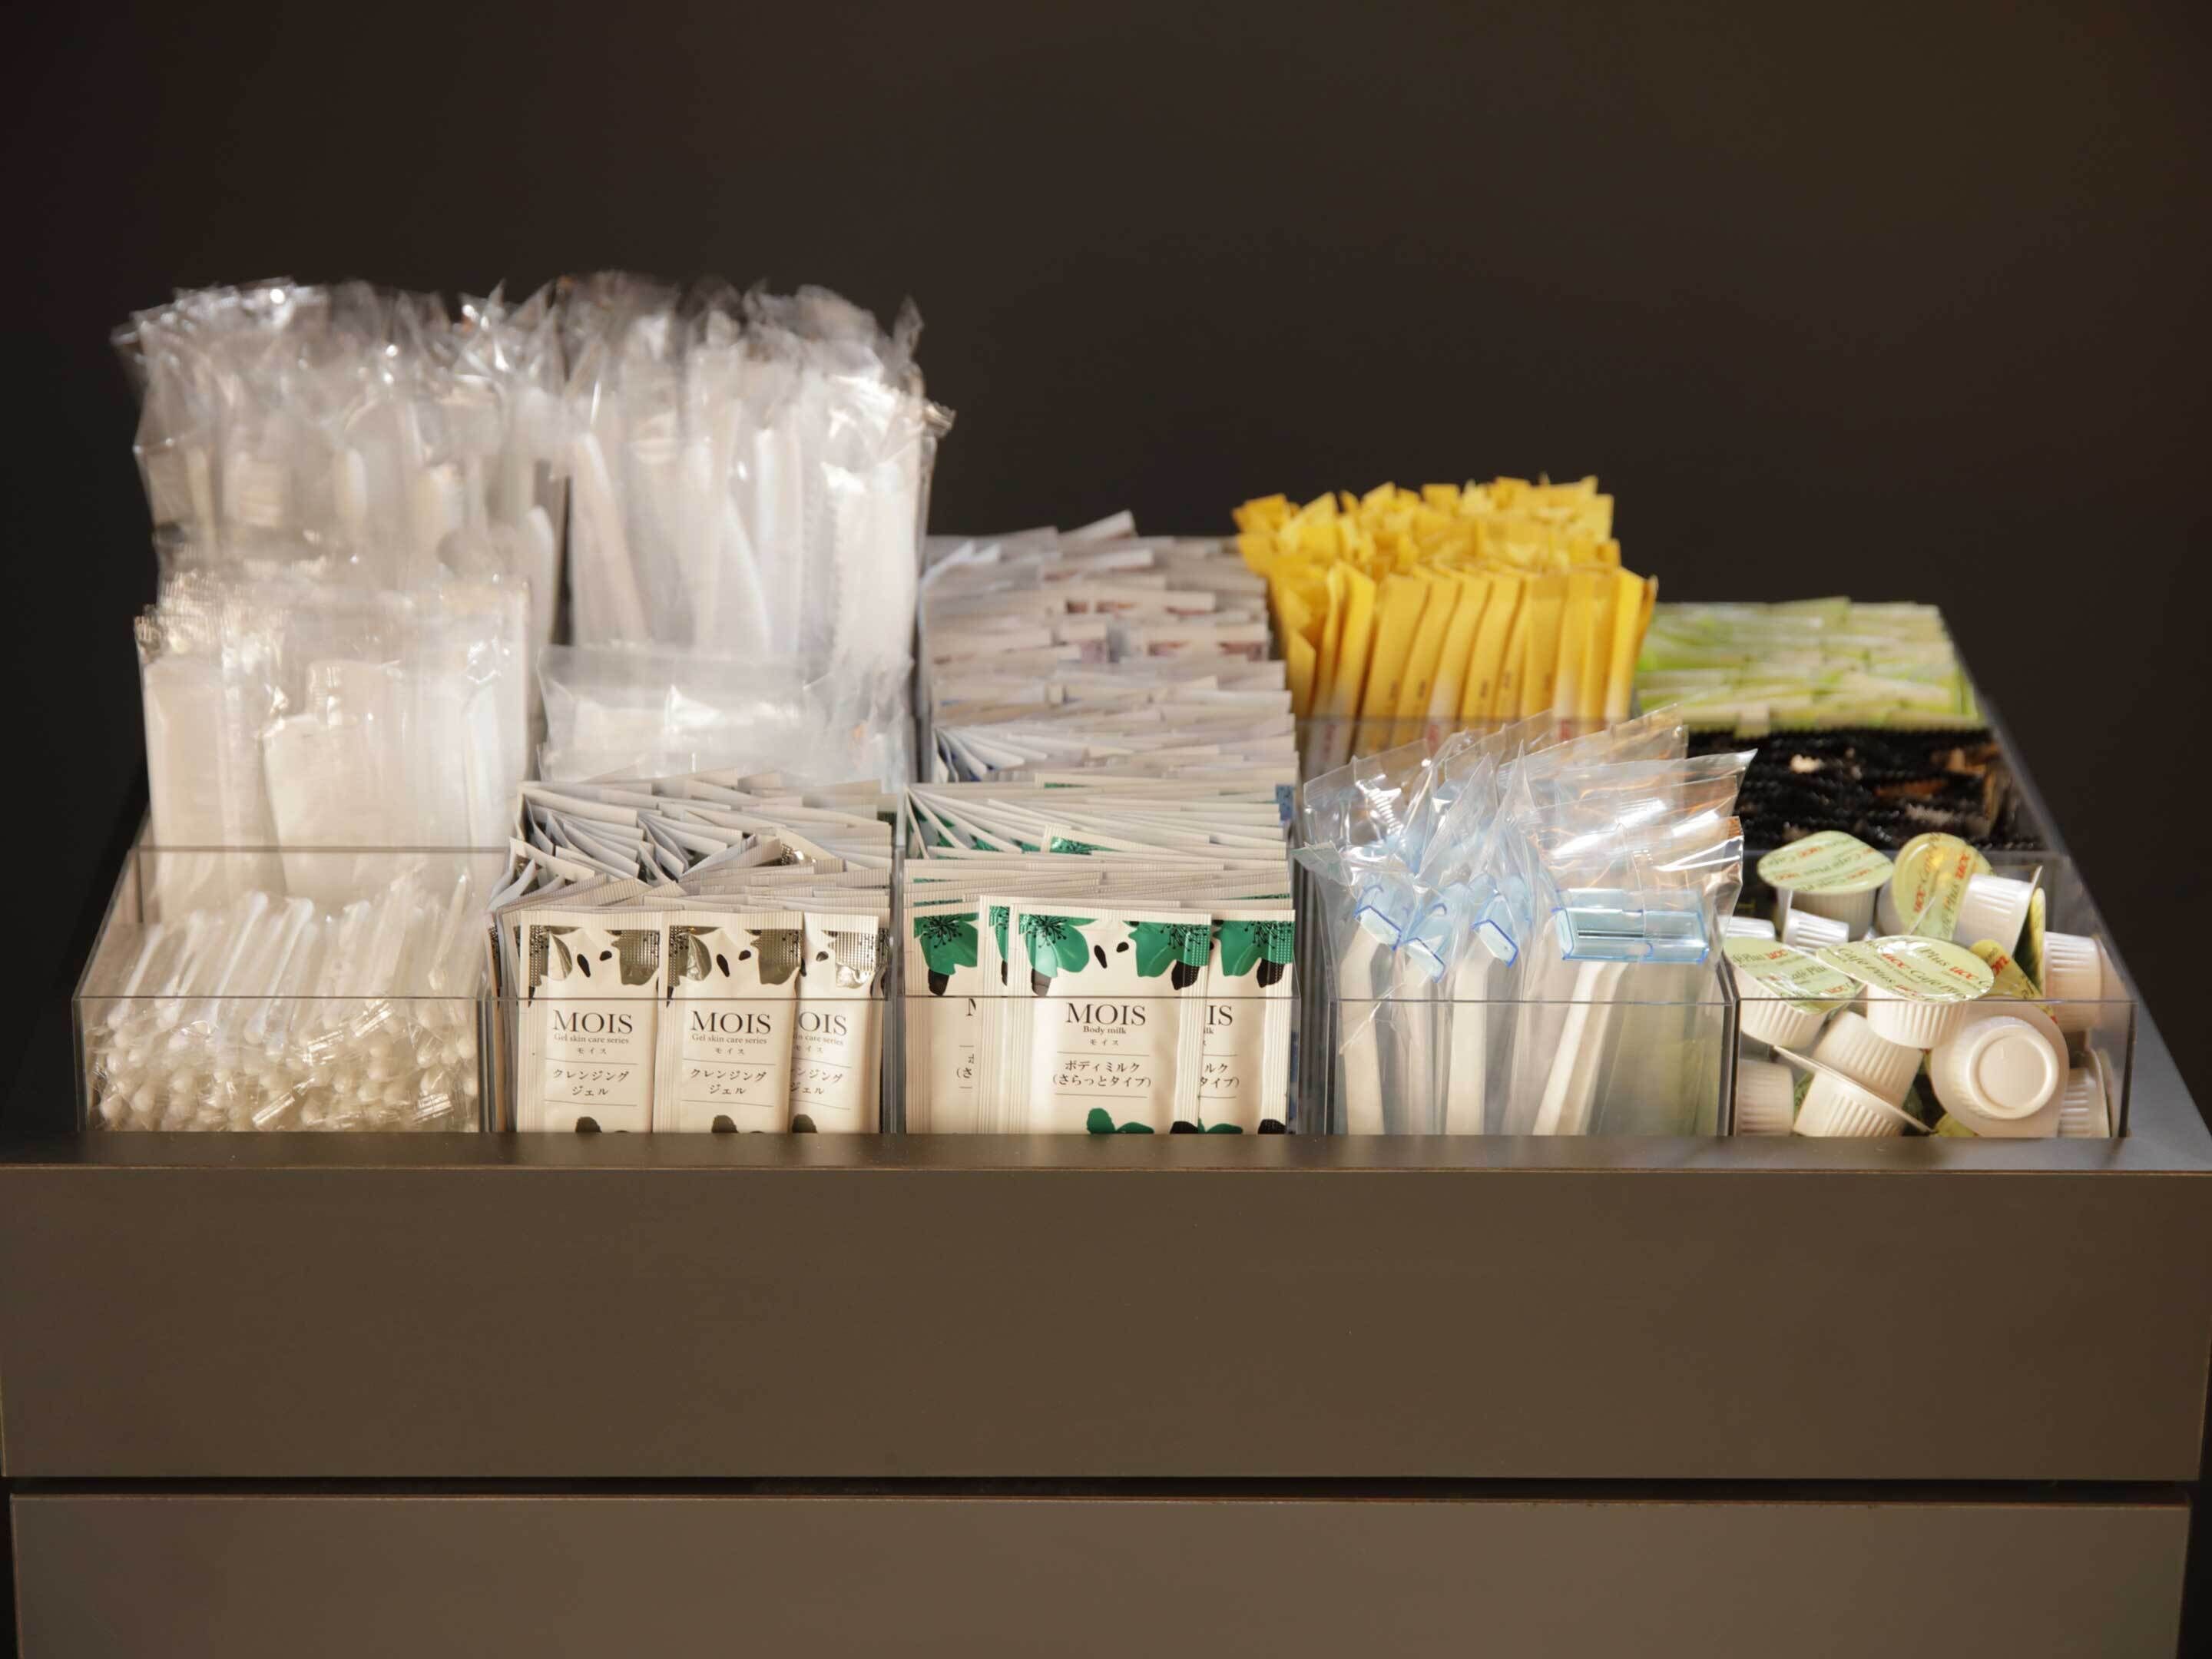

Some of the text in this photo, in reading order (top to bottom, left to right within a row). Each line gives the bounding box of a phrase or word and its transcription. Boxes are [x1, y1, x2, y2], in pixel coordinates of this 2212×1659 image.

[1065, 1002, 1146, 1026] MOIS
[552, 1008, 633, 1035] MOIS
[690, 1009, 771, 1035] MOIS
[1083, 1025, 1104, 1035] Body
[554, 1032, 568, 1041] Gel
[569, 1034, 586, 1043] skin
[607, 1036, 629, 1045] series
[691, 1032, 706, 1041] Gel
[707, 1034, 724, 1043] skin
[745, 1037, 767, 1045] series
[1065, 1060, 1140, 1073] ボディミルク
[553, 1068, 630, 1082] クレンジング
[690, 1068, 767, 1082] クレンジング
[572, 1084, 609, 1096] ジェル
[710, 1084, 747, 1094] ジェル
